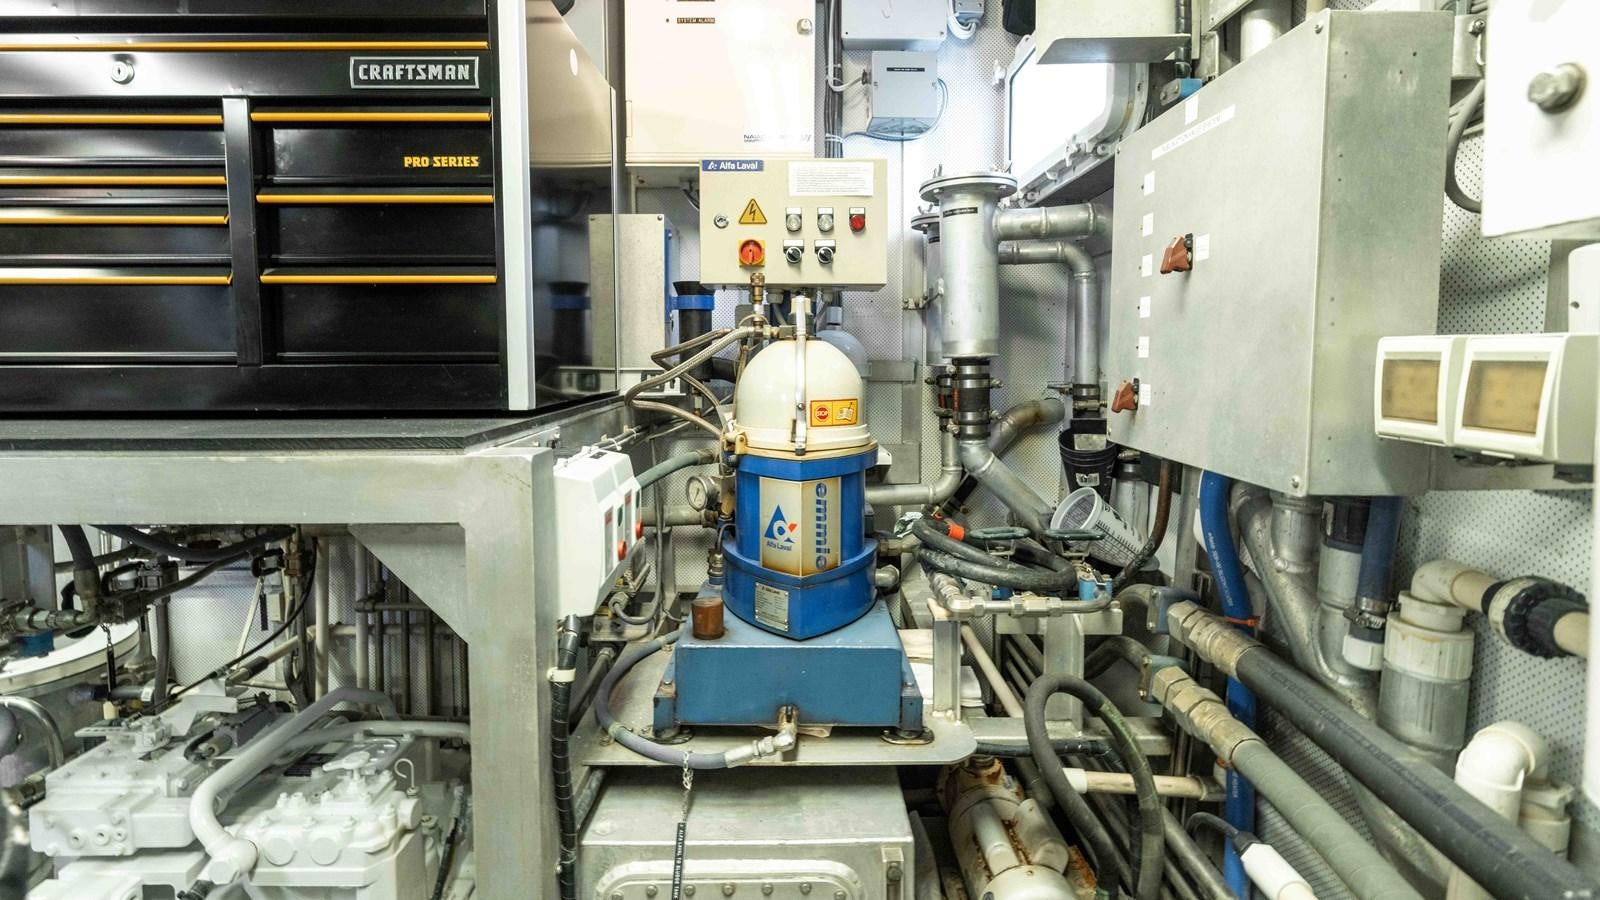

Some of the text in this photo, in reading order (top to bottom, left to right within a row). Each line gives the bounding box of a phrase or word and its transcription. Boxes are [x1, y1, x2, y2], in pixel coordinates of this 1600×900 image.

[359, 64, 469, 80] CRAFTSMAN
[404, 156, 479, 167] PRO SERIES
[720, 161, 758, 169] Alfa Laval
[816, 482, 830, 570] emmie
[777, 543, 792, 551] Laval
